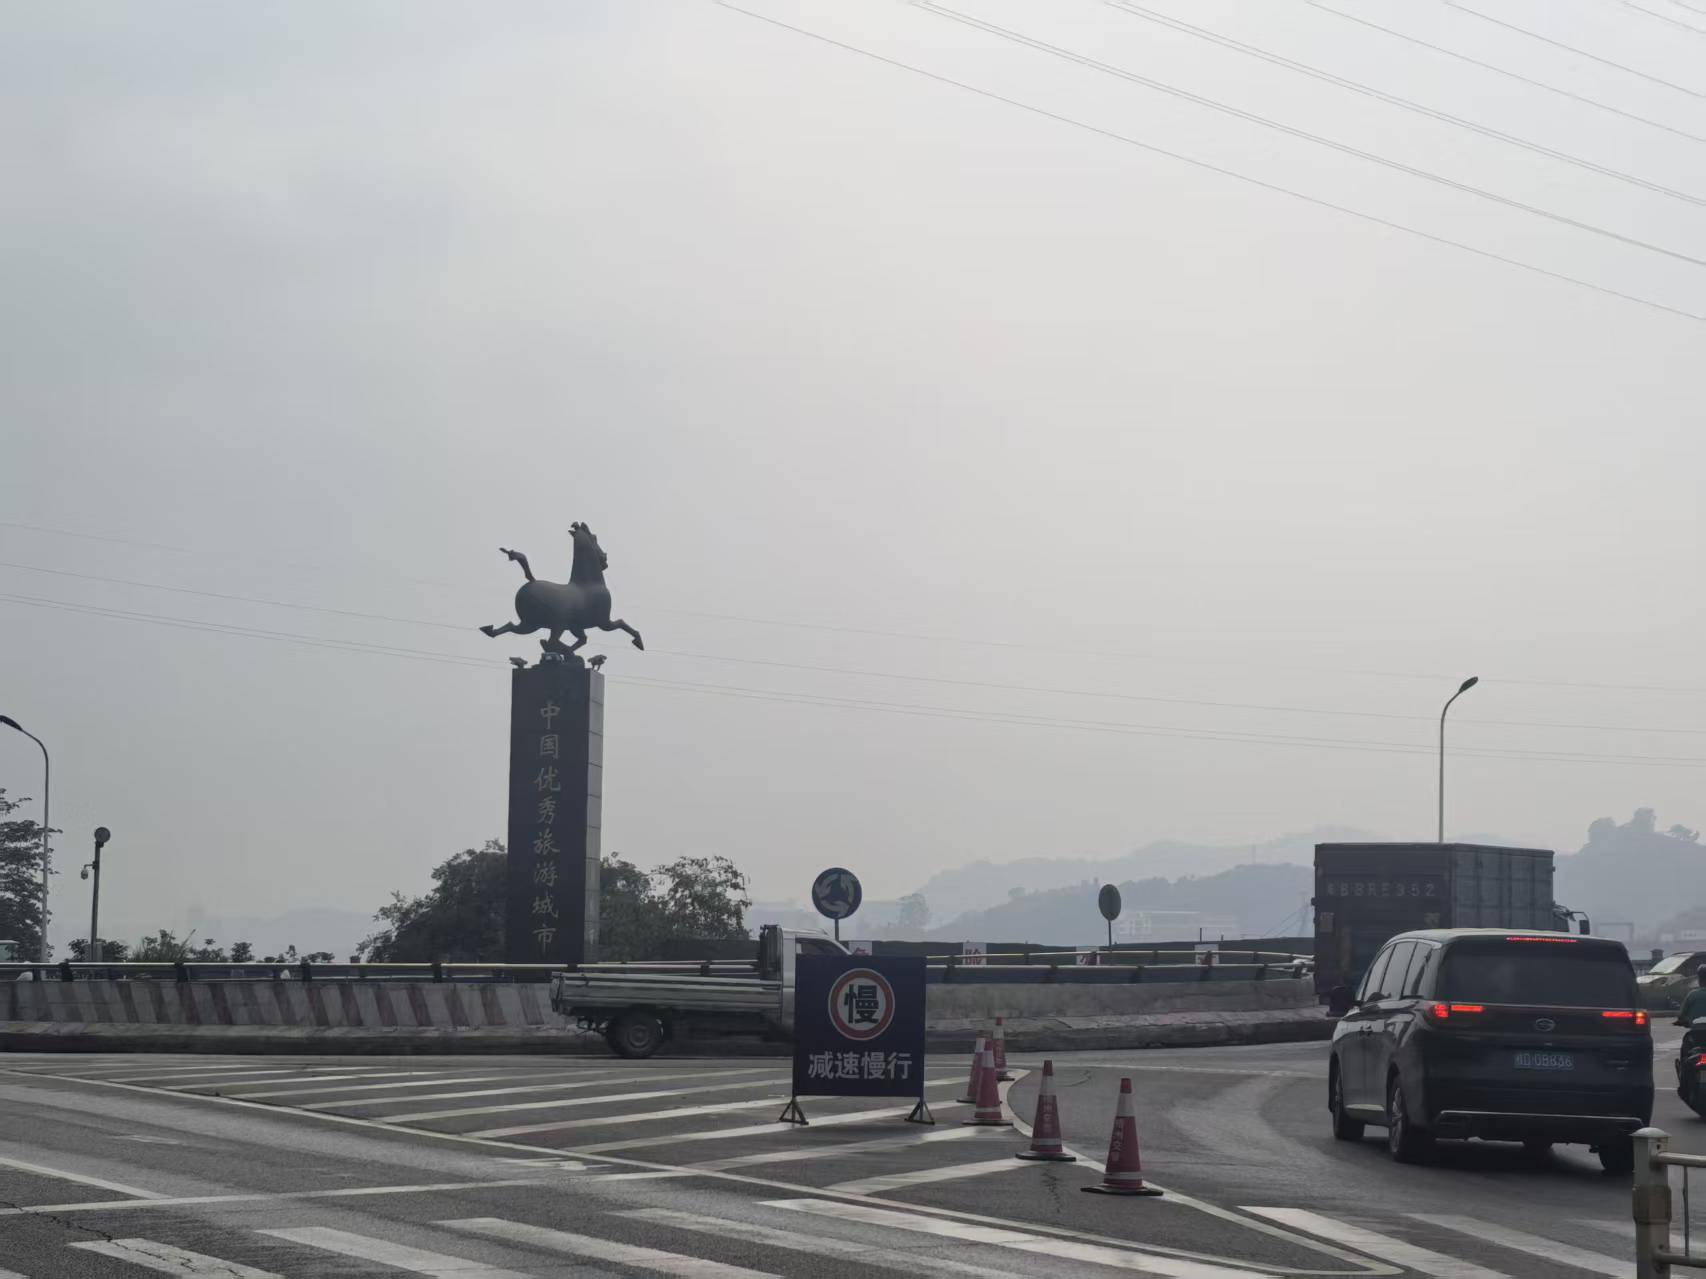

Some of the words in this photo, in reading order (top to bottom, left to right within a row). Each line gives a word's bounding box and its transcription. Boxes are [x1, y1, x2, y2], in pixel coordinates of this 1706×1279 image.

[532, 701, 561, 955] 中国优秀旅游城市
[844, 984, 879, 1024] 慢
[808, 1051, 912, 1079] 减速慢行
